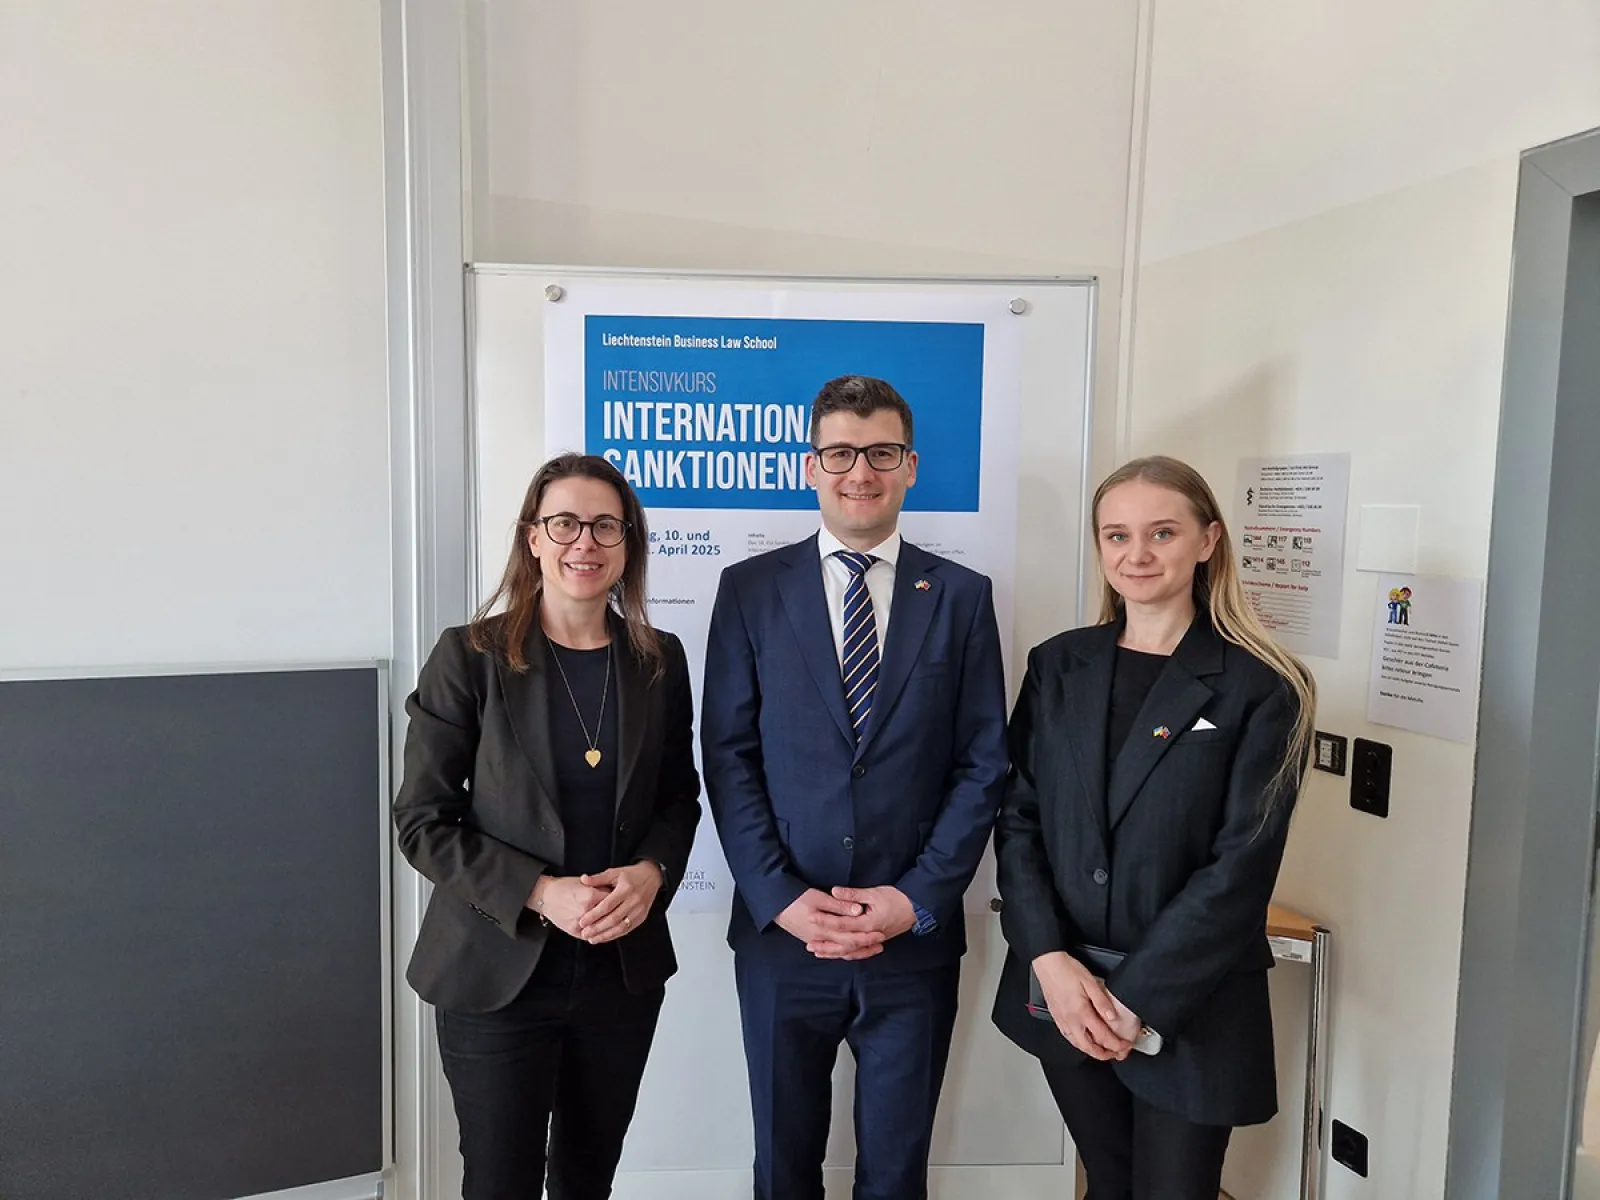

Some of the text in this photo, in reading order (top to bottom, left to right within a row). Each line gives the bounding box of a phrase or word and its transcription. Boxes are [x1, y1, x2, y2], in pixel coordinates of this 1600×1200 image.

[602, 333, 777, 350] Liechtenstein Business Law School
[603, 369, 717, 393] INTENSIVKURS
[665, 530, 683, 541] 10.
[686, 530, 711, 541] und
[658, 544, 688, 556] April
[691, 544, 721, 555] 2025
